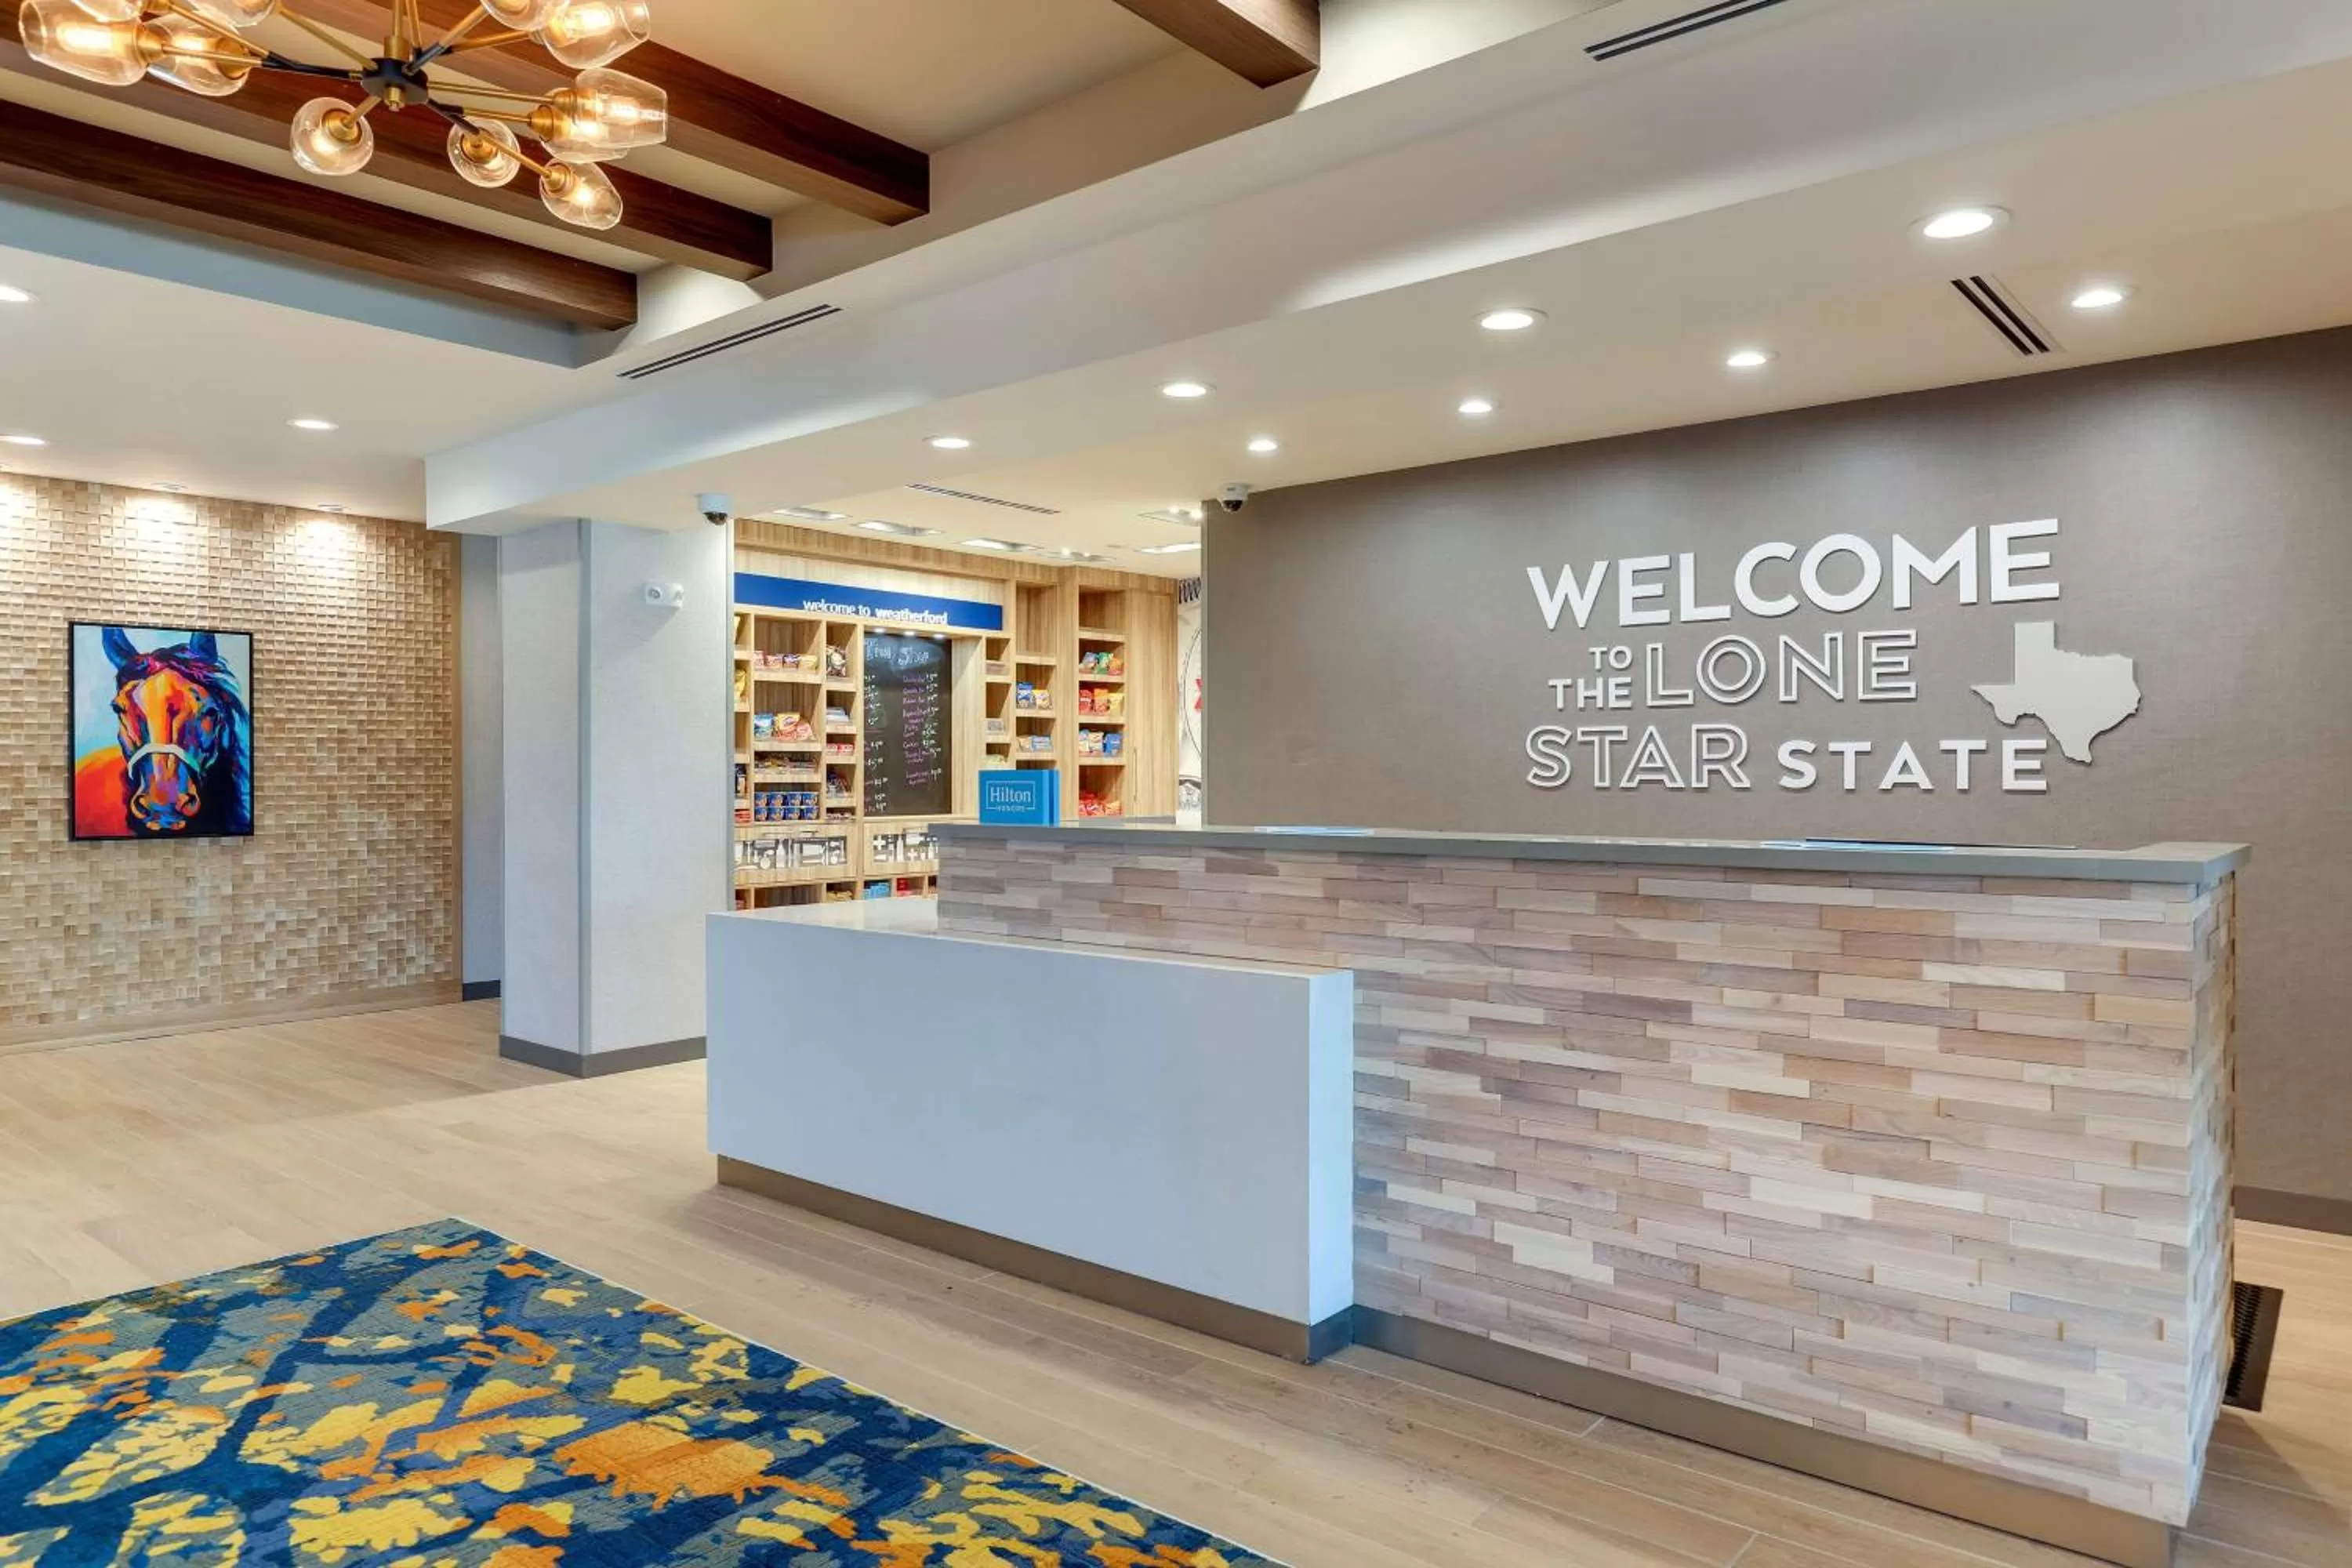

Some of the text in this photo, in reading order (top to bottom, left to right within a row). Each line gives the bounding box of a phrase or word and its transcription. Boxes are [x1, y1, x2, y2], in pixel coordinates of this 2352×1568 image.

[1527, 518, 2059, 630] WELCOME
[803, 598, 948, 625] welcome to weatherford
[1549, 629, 1916, 708] THE LONE
[1589, 646, 1632, 669] TO
[1526, 724, 2046, 789] STAR STATE
[990, 786, 1031, 802] Hilton
